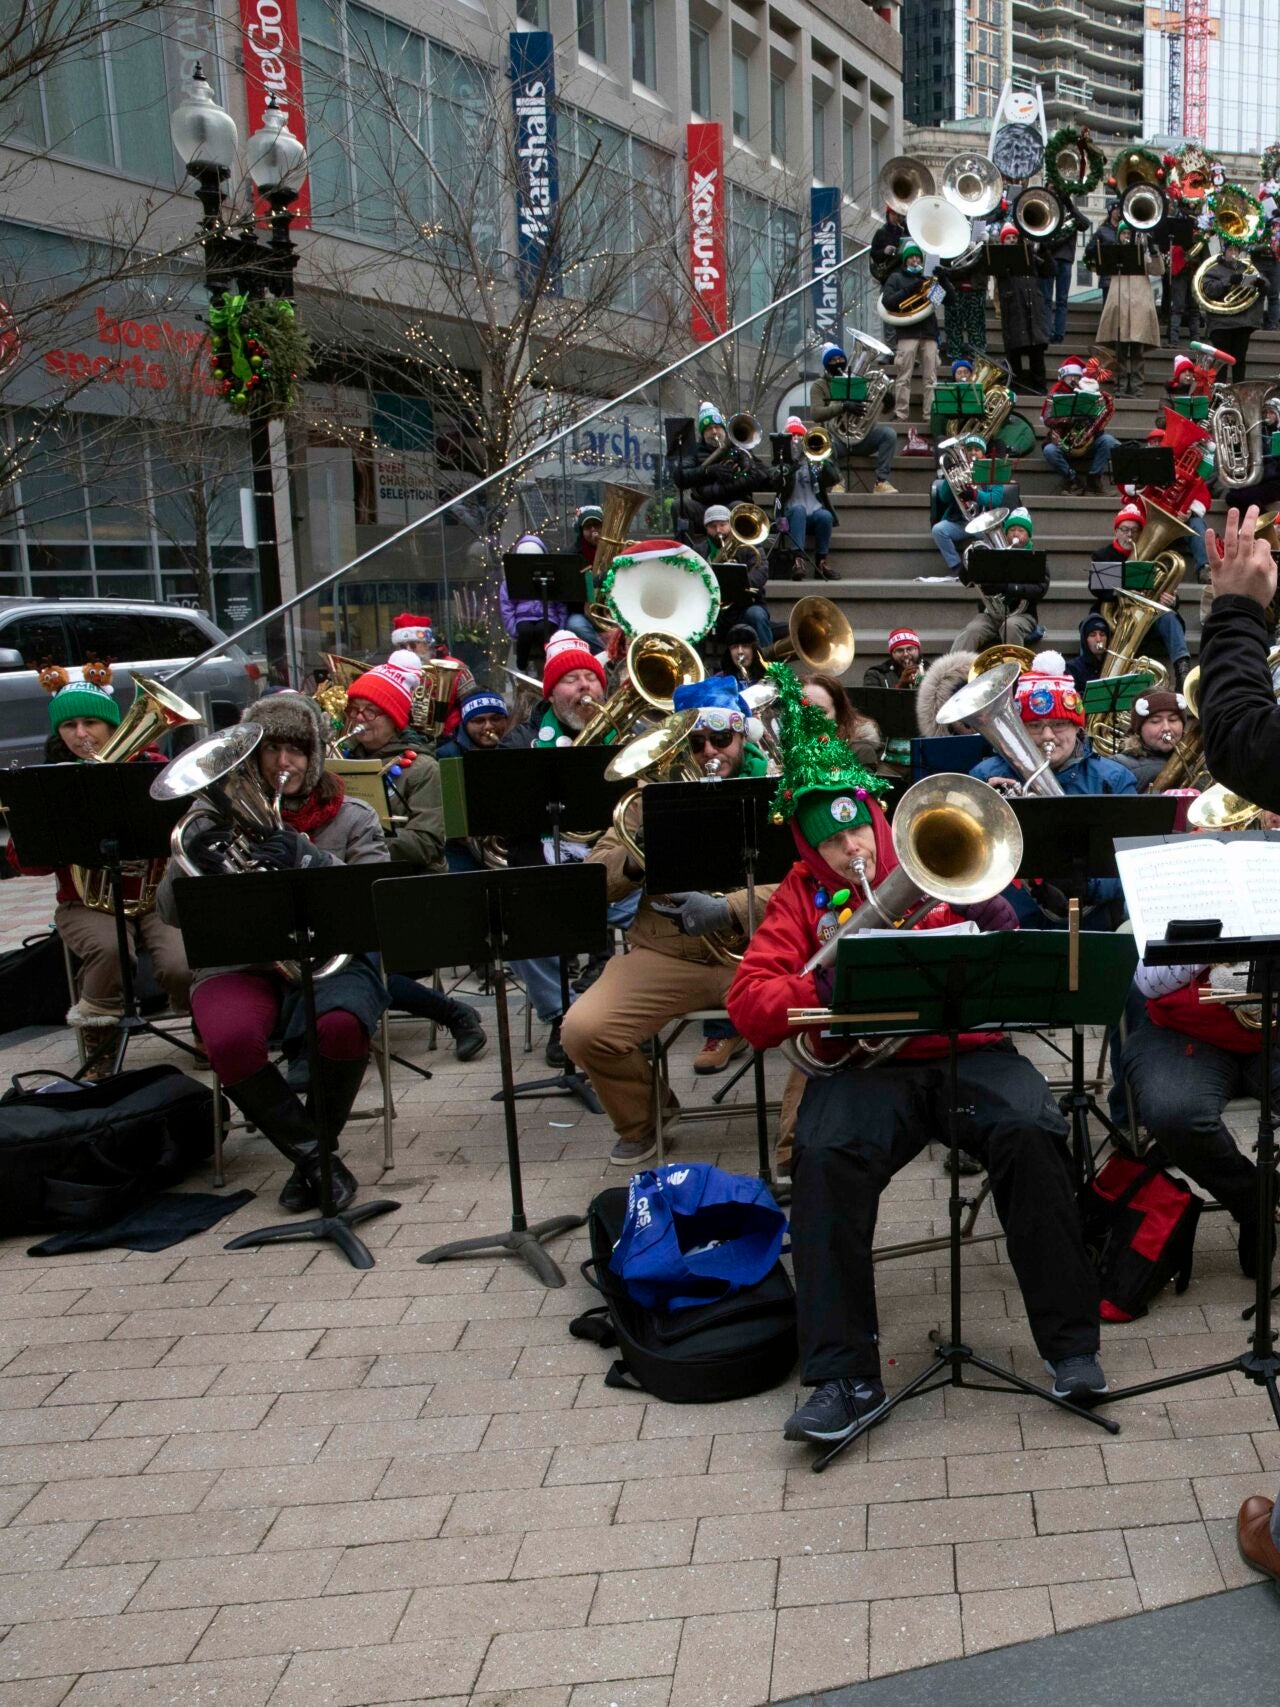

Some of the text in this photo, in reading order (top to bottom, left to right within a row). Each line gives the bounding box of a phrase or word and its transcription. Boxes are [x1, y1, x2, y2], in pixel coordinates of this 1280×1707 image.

[515, 80, 552, 247] Marshalls
[814, 220, 838, 337] Marshalls
[43, 348, 167, 390] sports
[540, 416, 657, 471] Marsha
[380, 487, 434, 500] SELECTION
[637, 1196, 652, 1227] CVS
